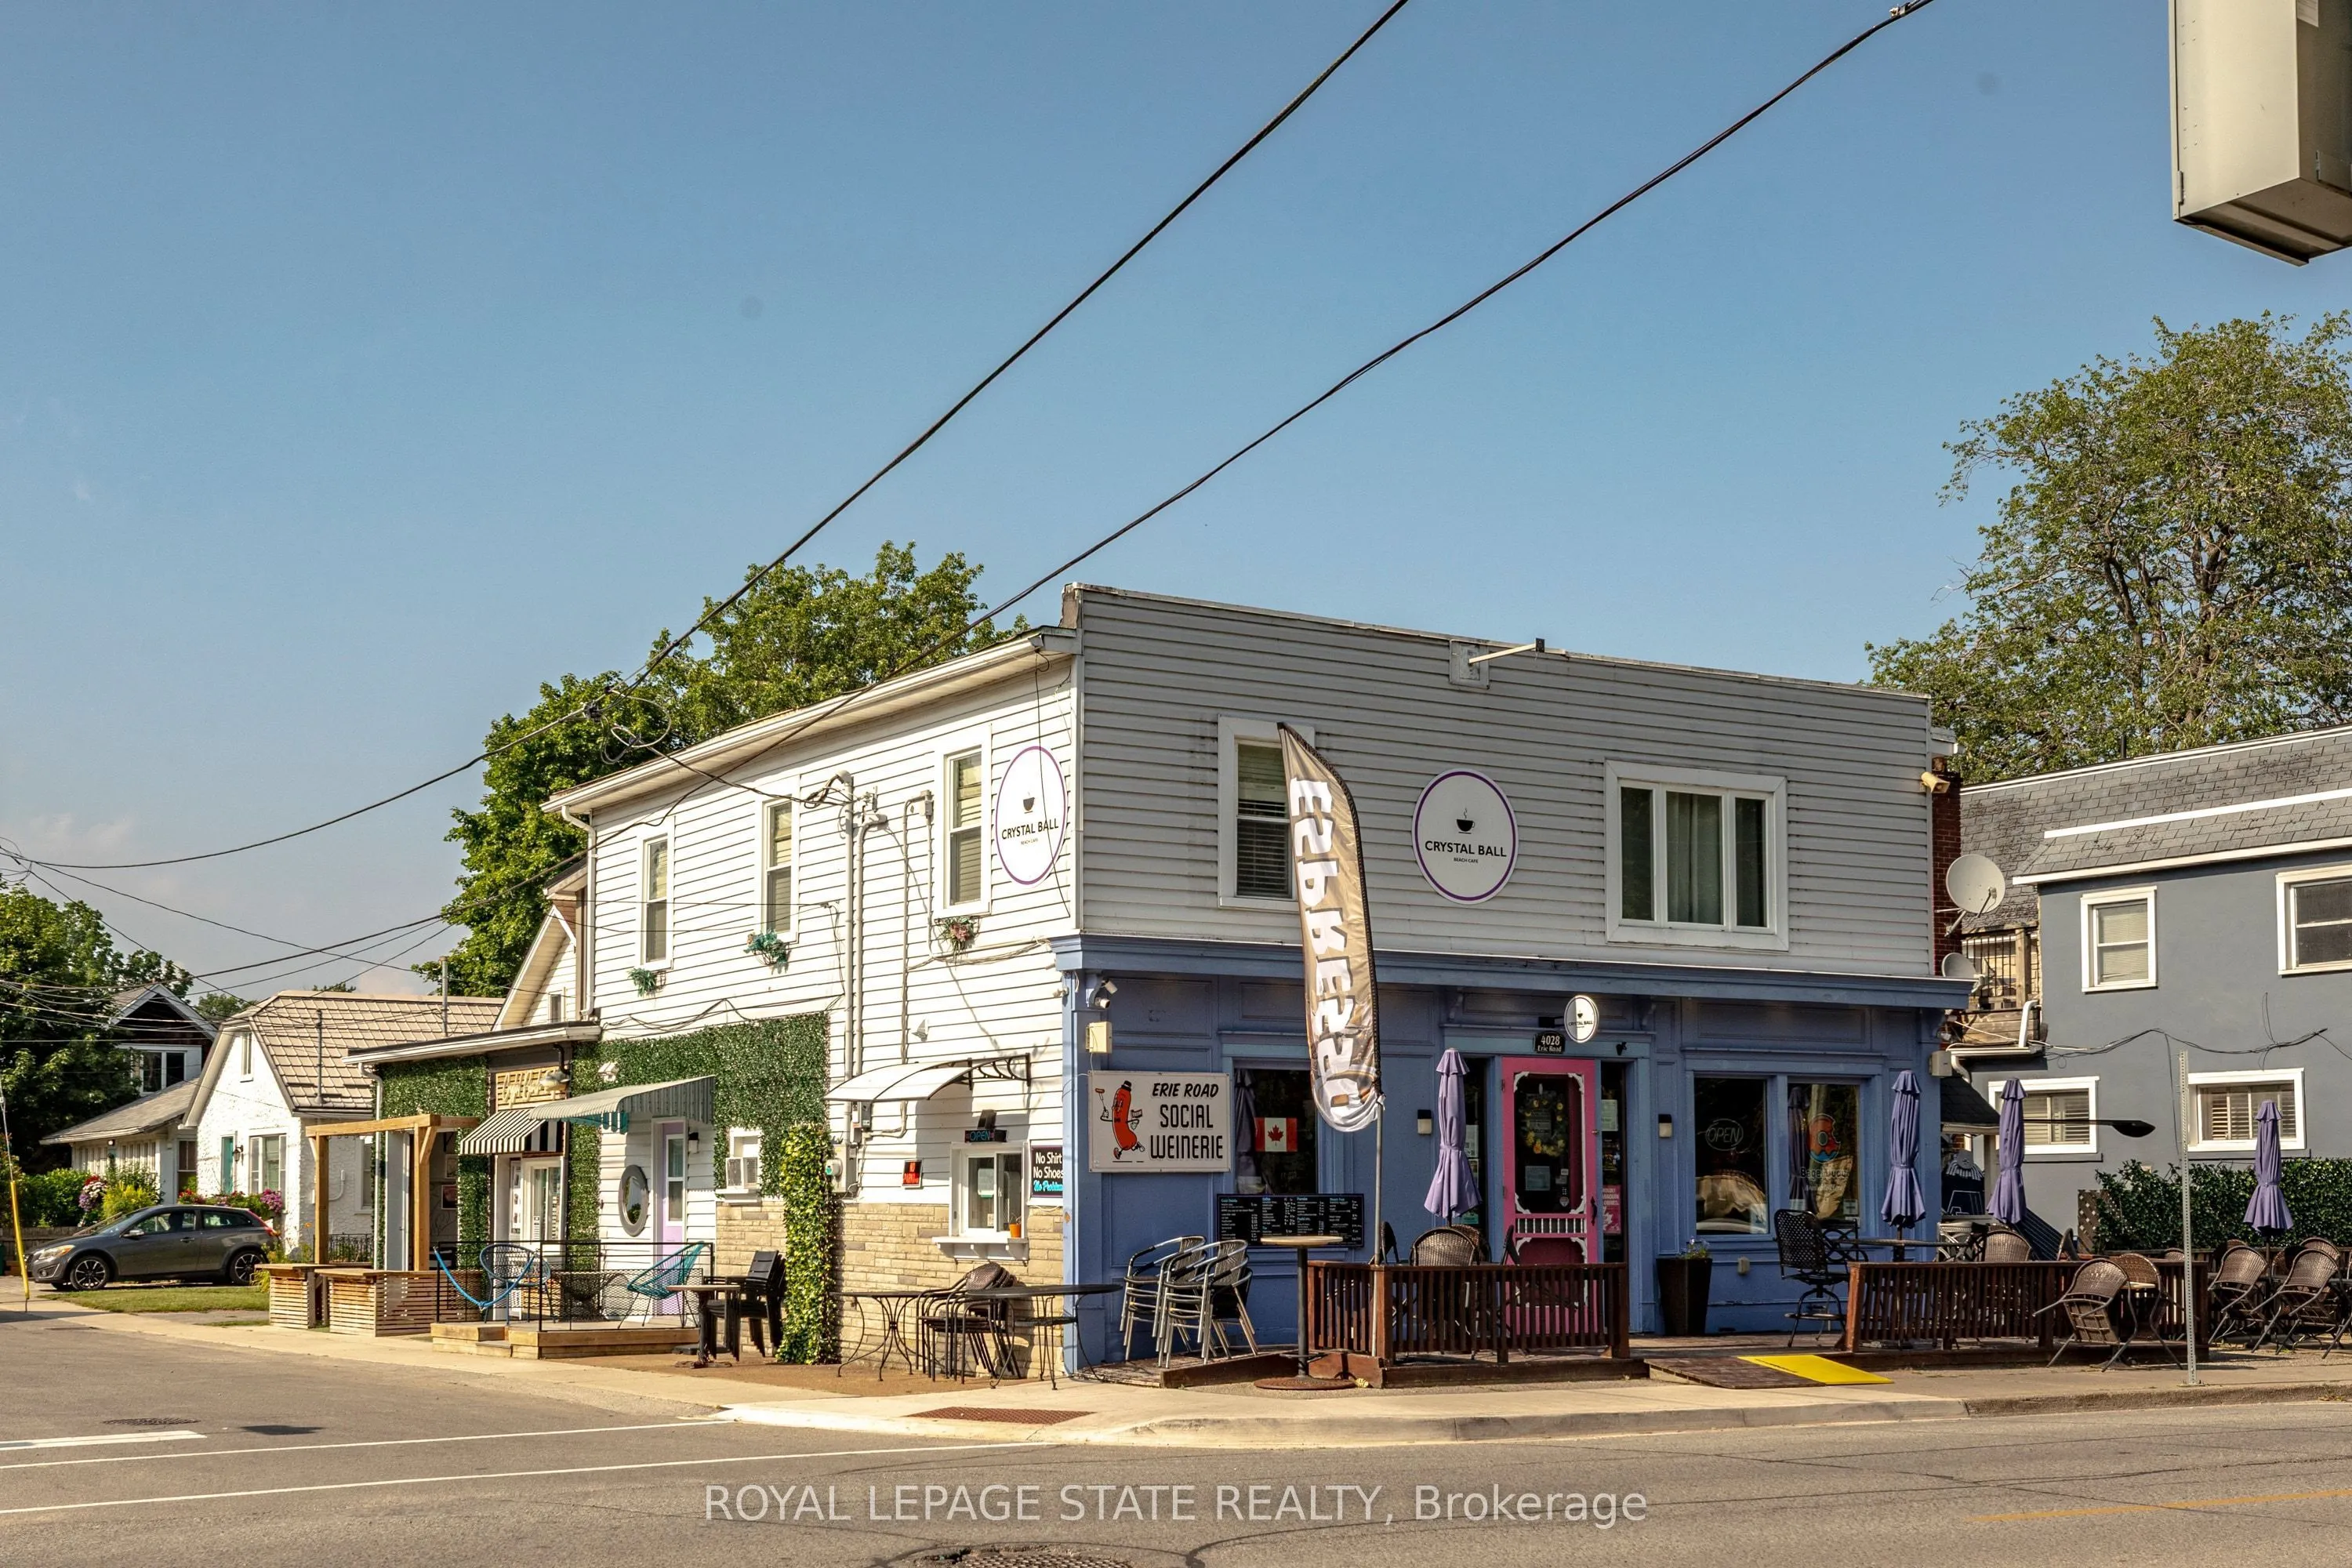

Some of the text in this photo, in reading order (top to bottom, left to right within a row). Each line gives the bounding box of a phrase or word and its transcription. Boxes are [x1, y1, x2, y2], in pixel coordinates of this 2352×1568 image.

[1001, 818, 1059, 840] CRYSTAL BALL
[1425, 840, 1507, 857] CRYSTAL BALL
[1541, 1035, 1560, 1046] 4028
[1152, 1083, 1219, 1098] ERIE ROAD
[1160, 1104, 1214, 1128] SOCIAL
[970, 1131, 990, 1141] OPEN
[1708, 1127, 1740, 1143] OPEN
[1036, 1152, 1062, 1164] No Shirt
[1033, 1166, 1043, 1178] No
